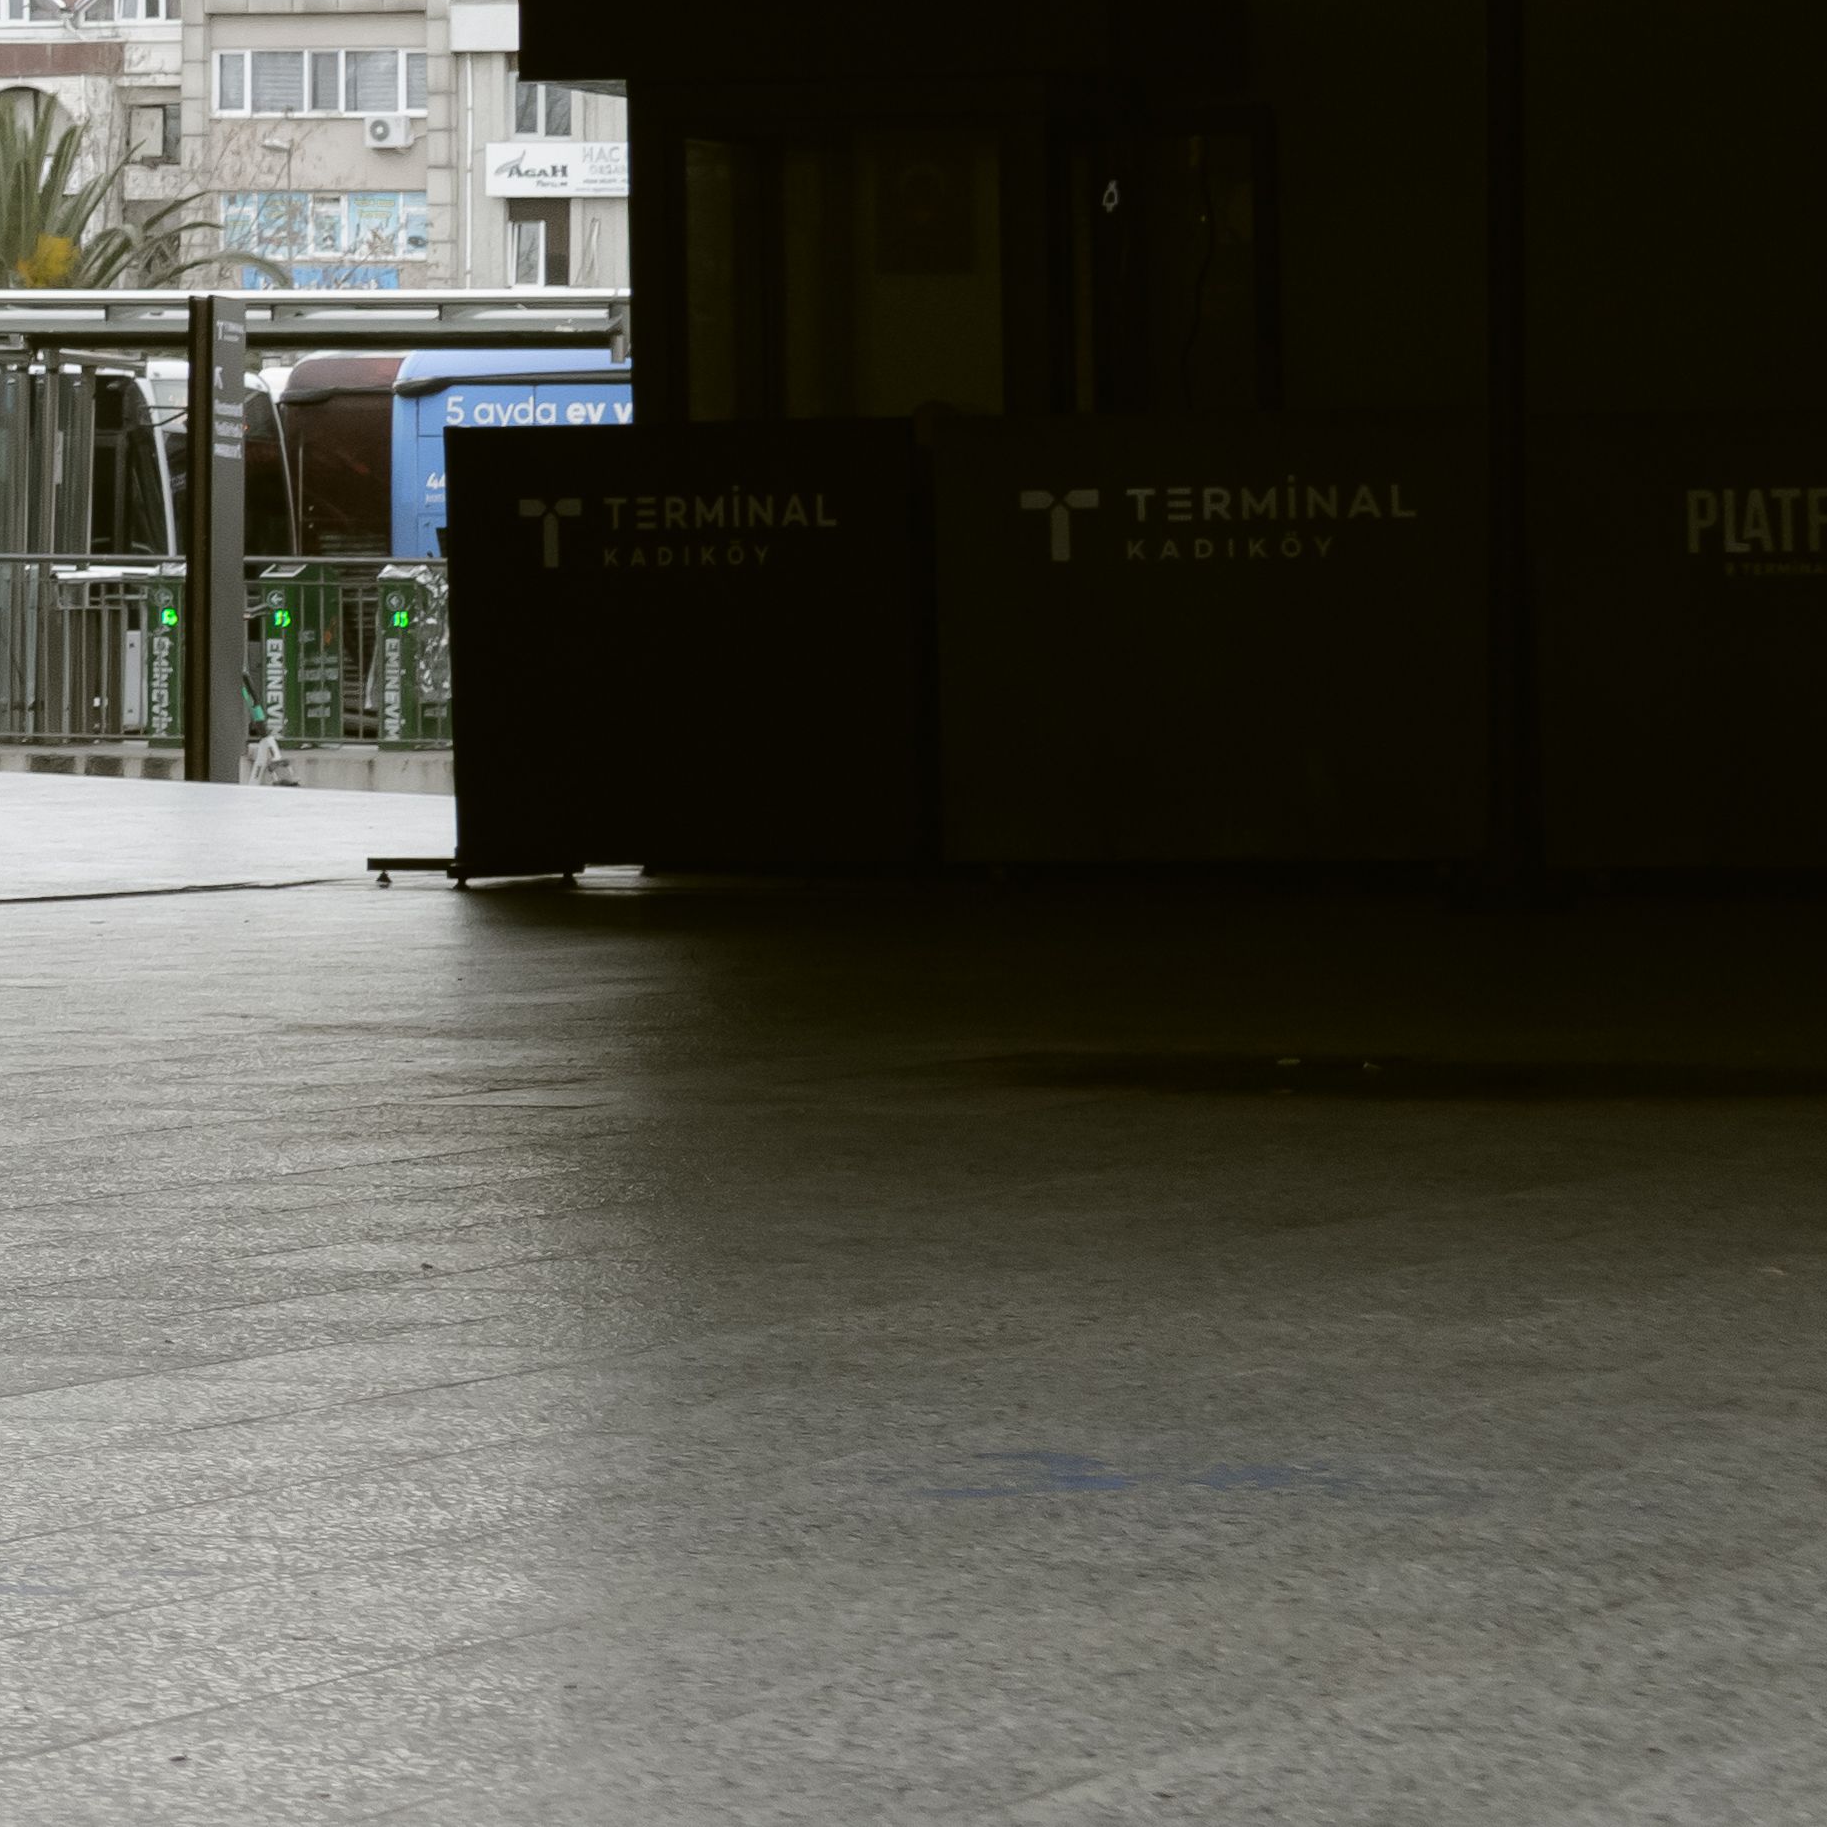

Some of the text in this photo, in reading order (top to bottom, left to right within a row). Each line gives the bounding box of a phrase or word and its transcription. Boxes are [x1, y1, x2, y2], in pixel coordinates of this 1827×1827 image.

[445, 395, 465, 425] 5
[473, 395, 556, 426] ayda
[566, 402, 605, 425] ev
[602, 484, 838, 531] TERMİNAL
[1125, 474, 1418, 522] TERMİNAL
[603, 539, 772, 568] KADIKÖY
[1125, 531, 1337, 562] KADIKÖY
[266, 638, 288, 740] EMİNEVİM
[384, 638, 406, 741] EMİNEVİM
